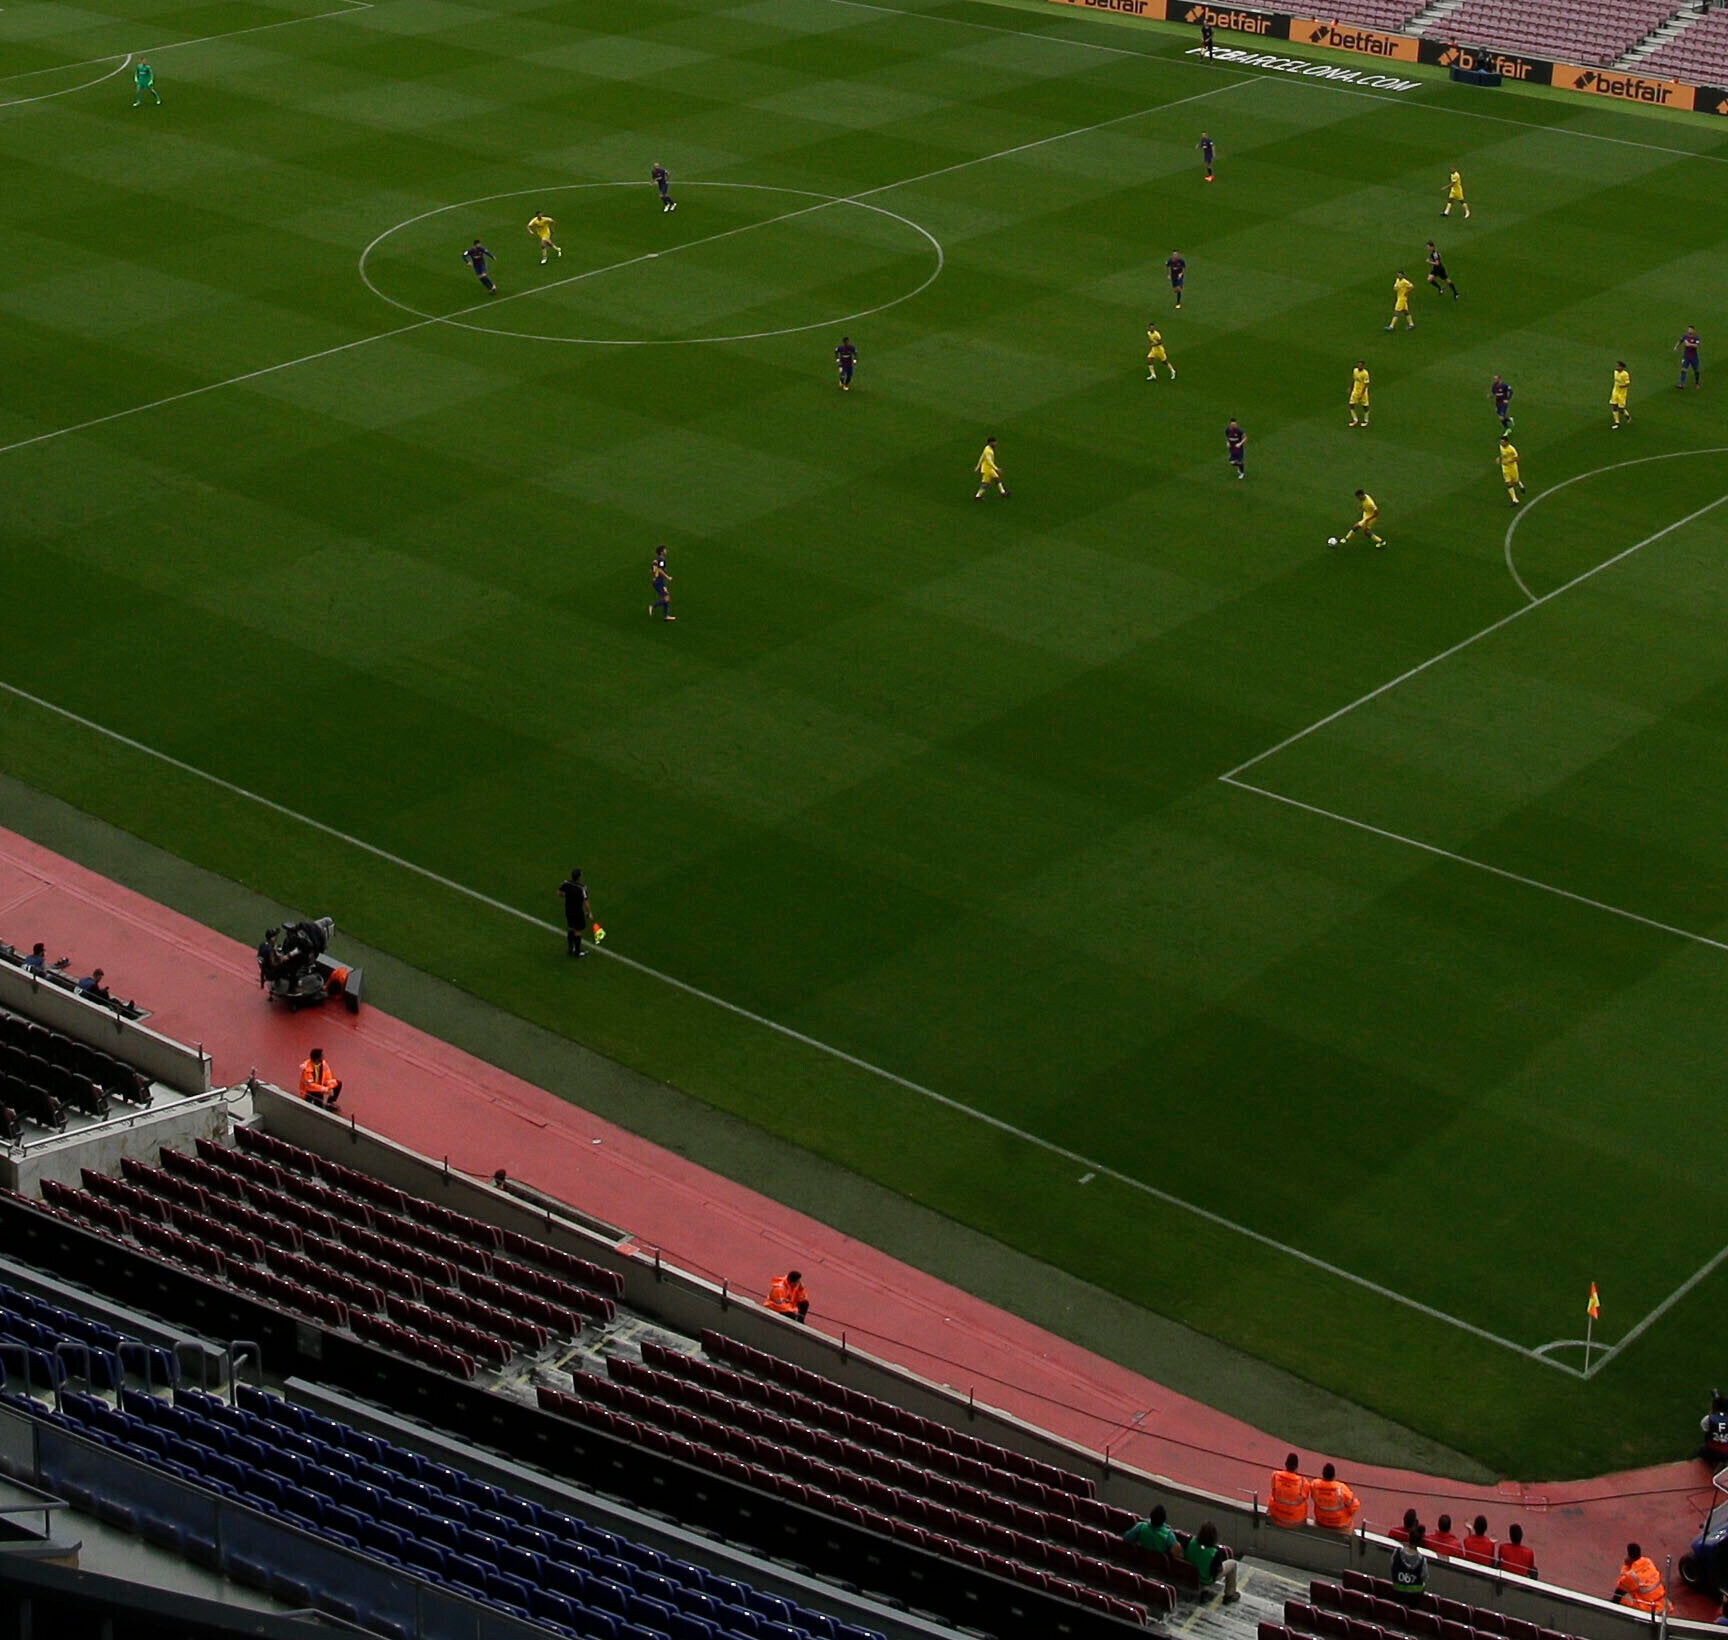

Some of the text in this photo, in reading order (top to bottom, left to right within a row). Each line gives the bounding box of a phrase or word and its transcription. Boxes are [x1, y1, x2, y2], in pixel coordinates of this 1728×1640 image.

[1208, 10, 1271, 35] betfair
[1331, 29, 1398, 57] betfair
[1459, 50, 1532, 81] bfair
[1595, 74, 1671, 102] betfair
